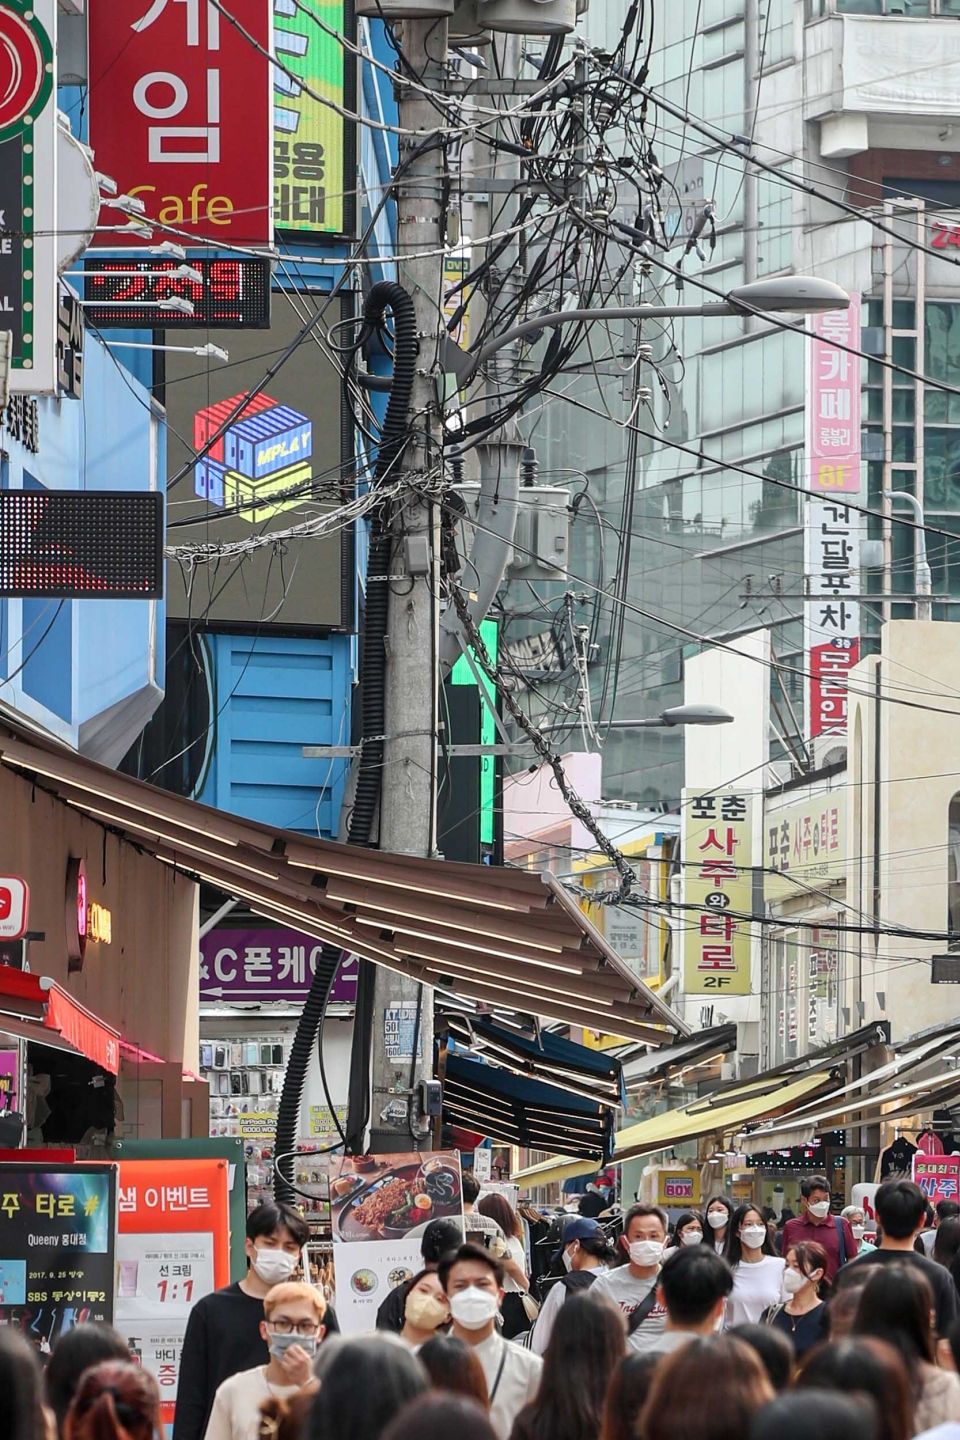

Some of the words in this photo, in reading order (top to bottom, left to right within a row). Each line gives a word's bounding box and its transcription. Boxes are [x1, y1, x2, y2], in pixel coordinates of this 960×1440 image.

[128, 184, 234, 226] Cafe
[257, 431, 310, 467] MPLAY
[820, 506, 853, 631] 건달포차
[691, 796, 747, 822] 포춘
[703, 977, 732, 989] 2F
[144, 1186, 211, 1211] 이벤트
[666, 1185, 691, 1196] BOX
[920, 1178, 957, 1198] 사주
[36, 1193, 76, 1218] 타로
[27, 1234, 59, 1246] Queeny
[159, 1264, 169, 1277] 선
[172, 1264, 191, 1277] 크림
[27, 1291, 48, 1302] SBS
[157, 1279, 194, 1303] 1:1
[155, 1350, 176, 1361] 바디
